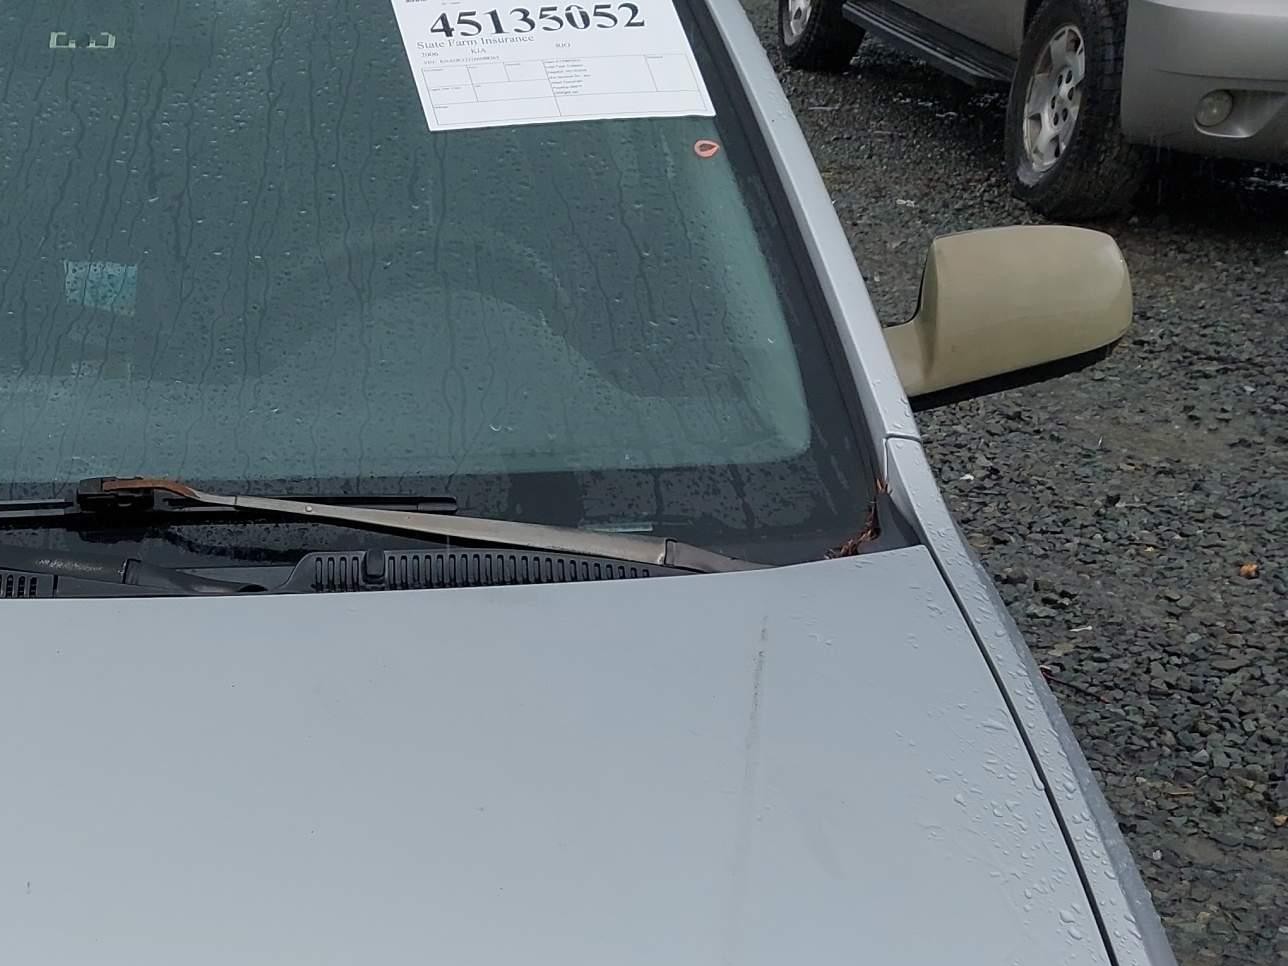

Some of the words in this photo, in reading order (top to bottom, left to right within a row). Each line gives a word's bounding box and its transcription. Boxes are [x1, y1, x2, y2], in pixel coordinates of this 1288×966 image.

[429, 2, 645, 38] 45135052
[416, 41, 445, 50] State
[448, 38, 478, 48] Farm
[481, 35, 535, 46] Insurance
